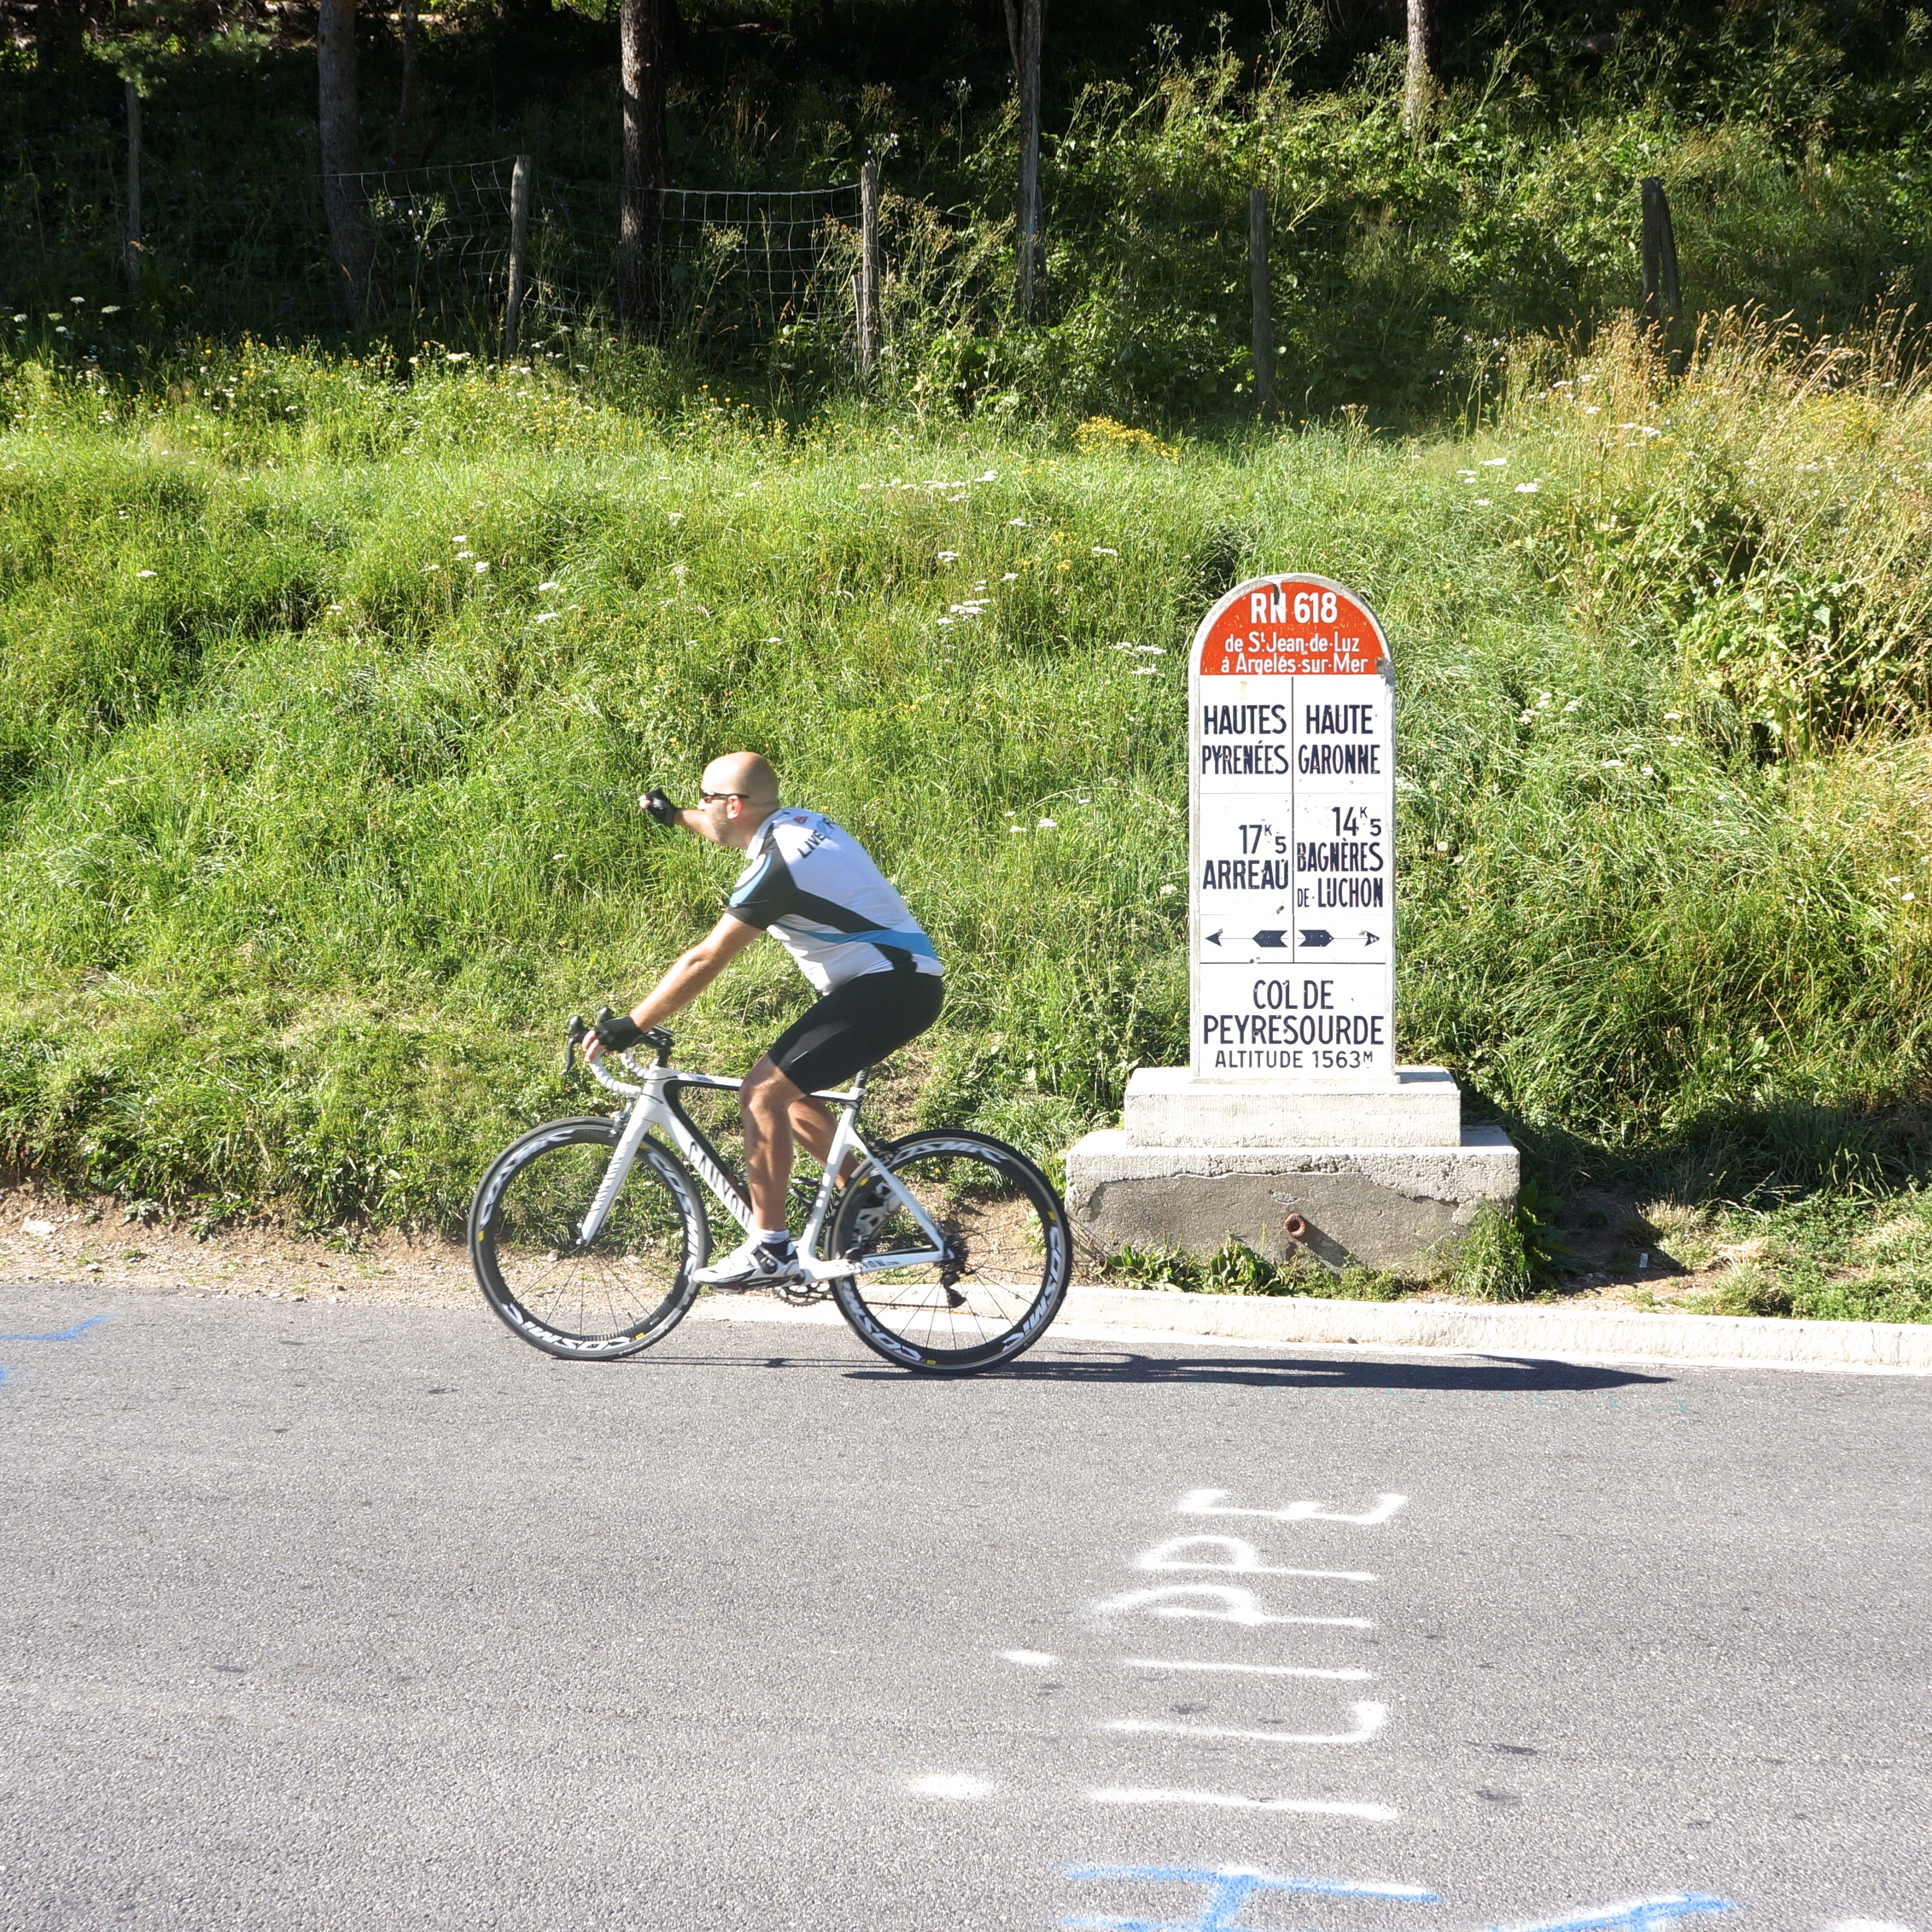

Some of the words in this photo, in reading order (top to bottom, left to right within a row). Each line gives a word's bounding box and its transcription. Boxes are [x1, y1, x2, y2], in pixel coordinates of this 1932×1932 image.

[1251, 592, 1287, 624] RN
[1293, 592, 1338, 624] 618
[1224, 633, 1244, 652] de
[1204, 704, 1287, 735] HAUTES
[1306, 704, 1374, 735] HAUTE
[1201, 740, 1289, 774] PYRENÉES
[1298, 744, 1380, 774] GARONNE
[797, 830, 826, 859] LIVE
[1297, 838, 1384, 873] BAGNÈRES
[1202, 860, 1289, 890] ARREAU
[1297, 888, 1310, 908] DE
[1317, 878, 1383, 908] LUCHON
[1252, 979, 1298, 1010] COL
[1304, 980, 1334, 1010] DE
[1204, 1015, 1384, 1045] PEYRESOURDE
[1215, 1050, 1304, 1069] ALTITUDE
[502, 1303, 632, 1351] COSMIC
